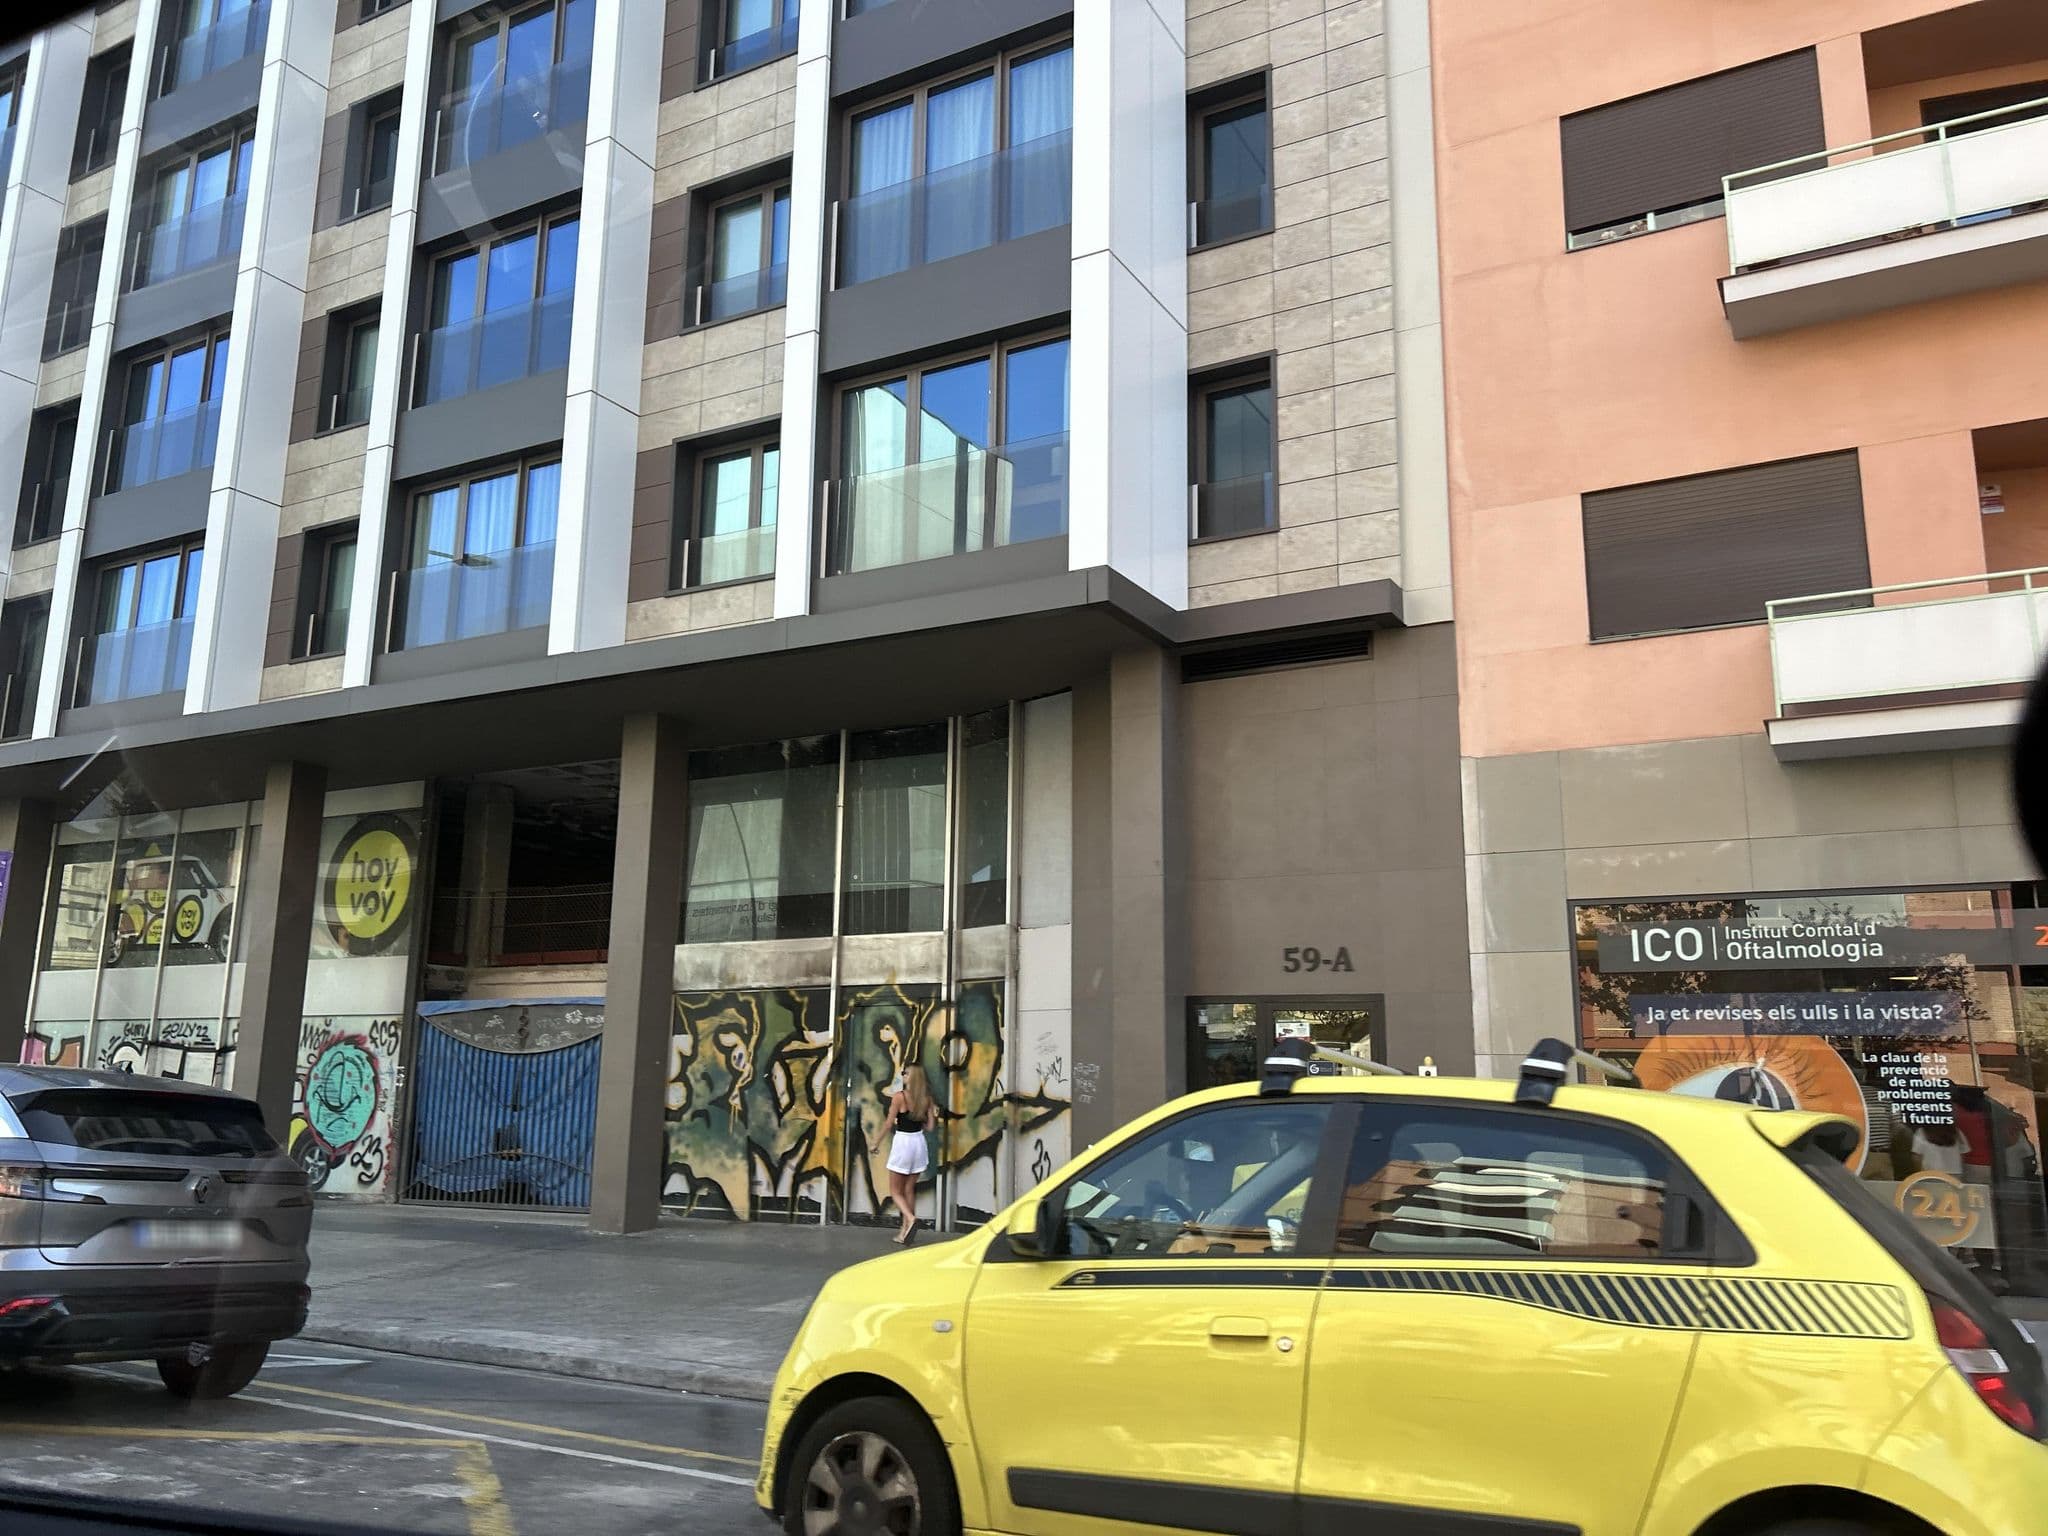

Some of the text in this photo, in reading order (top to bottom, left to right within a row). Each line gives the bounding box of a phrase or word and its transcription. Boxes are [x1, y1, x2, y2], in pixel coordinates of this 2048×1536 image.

[351, 850, 399, 889] hoy
[350, 890, 396, 923] voy
[1725, 925, 1789, 940] Institut
[1792, 922, 1859, 938] Comtal
[1631, 927, 1703, 962] ICO
[1726, 938, 1883, 962] Oftalmologia
[1282, 946, 1355, 973] 59-A
[1646, 1003, 1943, 1024] Ja et revises els ulls i la vista?
[1862, 1052, 1947, 1063] La clau de la
[1880, 1065, 1949, 1077] prevenció
[1888, 1076, 1950, 1088] de molts
[1877, 1088, 1952, 1101] problemes
[1891, 1102, 1953, 1113] presents
[1902, 1113, 1954, 1124] i futurs
